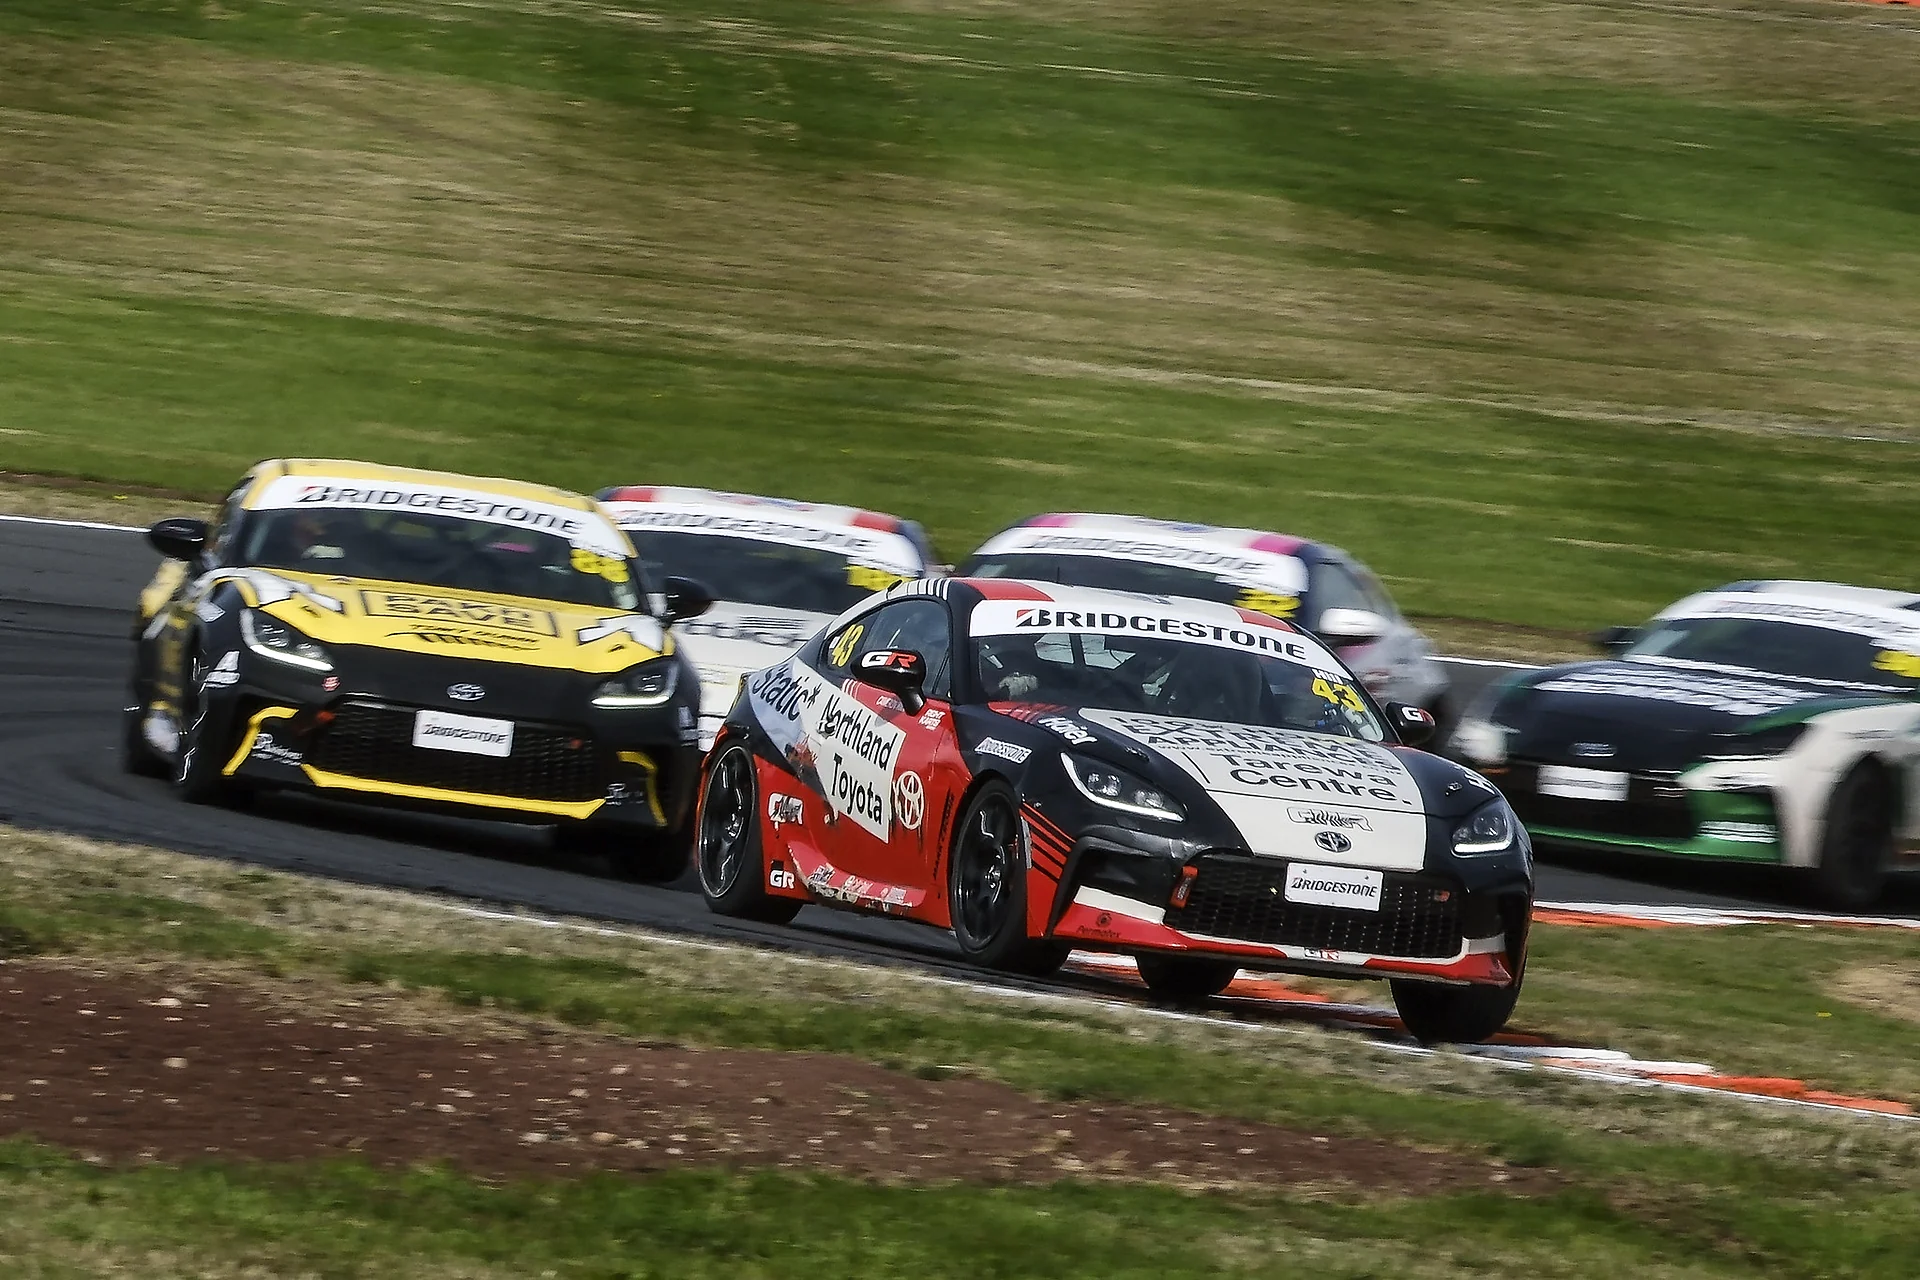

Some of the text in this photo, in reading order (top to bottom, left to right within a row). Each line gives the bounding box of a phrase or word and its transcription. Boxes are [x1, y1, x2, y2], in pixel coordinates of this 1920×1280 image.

[297, 485, 584, 533] BRIDGESTONE
[831, 624, 863, 667] 43
[1015, 609, 1306, 660] BRIDGESTONE
[861, 651, 918, 668] GR
[1312, 669, 1342, 685] Hill
[1311, 677, 1365, 713] 43
[819, 694, 898, 771] Northland
[1038, 716, 1098, 745] Haier
[1208, 753, 1397, 787] Tarewa
[1230, 767, 1413, 805] Centre.
[832, 753, 883, 825] Toyota
[770, 870, 795, 889] GR
[1291, 877, 1379, 898] BRIDGESTONE
